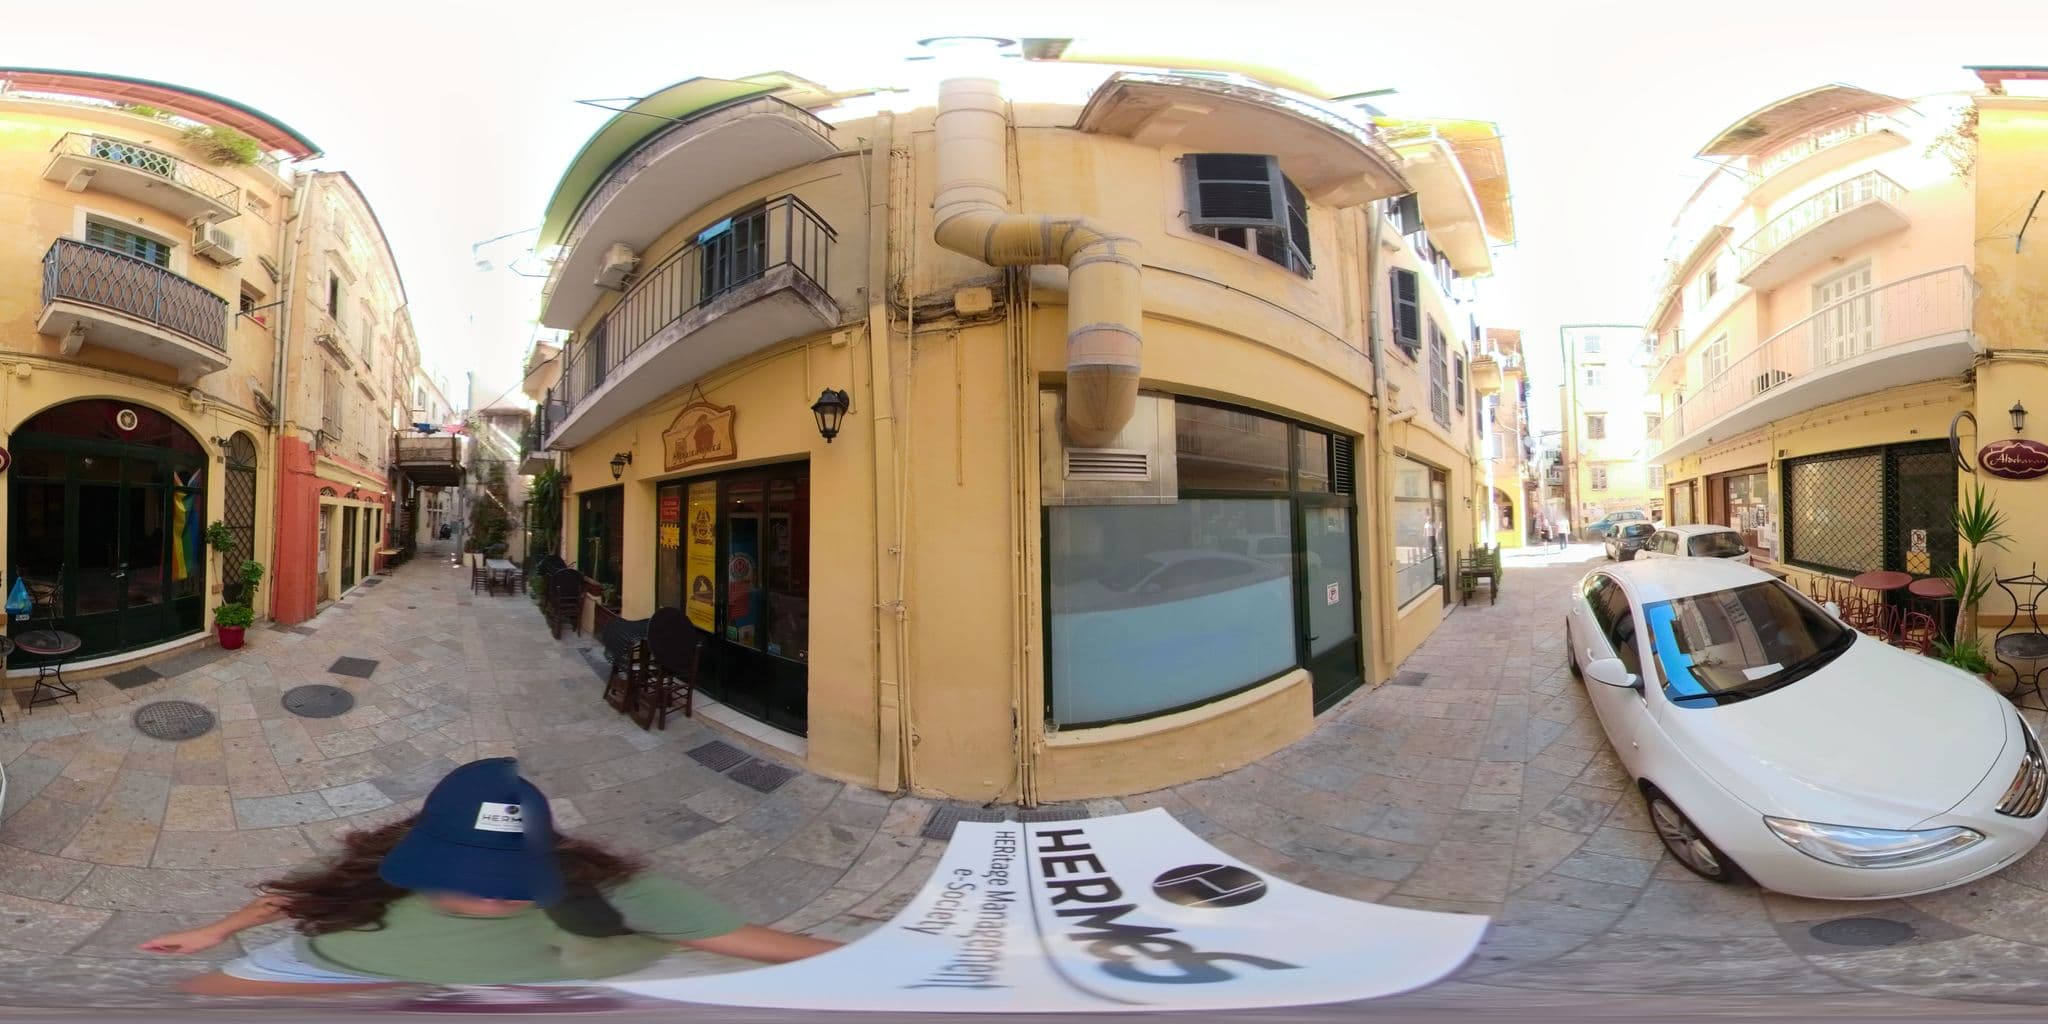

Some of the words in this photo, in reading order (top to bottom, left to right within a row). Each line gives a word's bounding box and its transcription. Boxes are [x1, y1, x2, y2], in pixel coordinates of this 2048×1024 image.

[981, 831, 1016, 887] HERitage
[903, 868, 977, 936] e-Society
[903, 890, 1016, 989] Management
